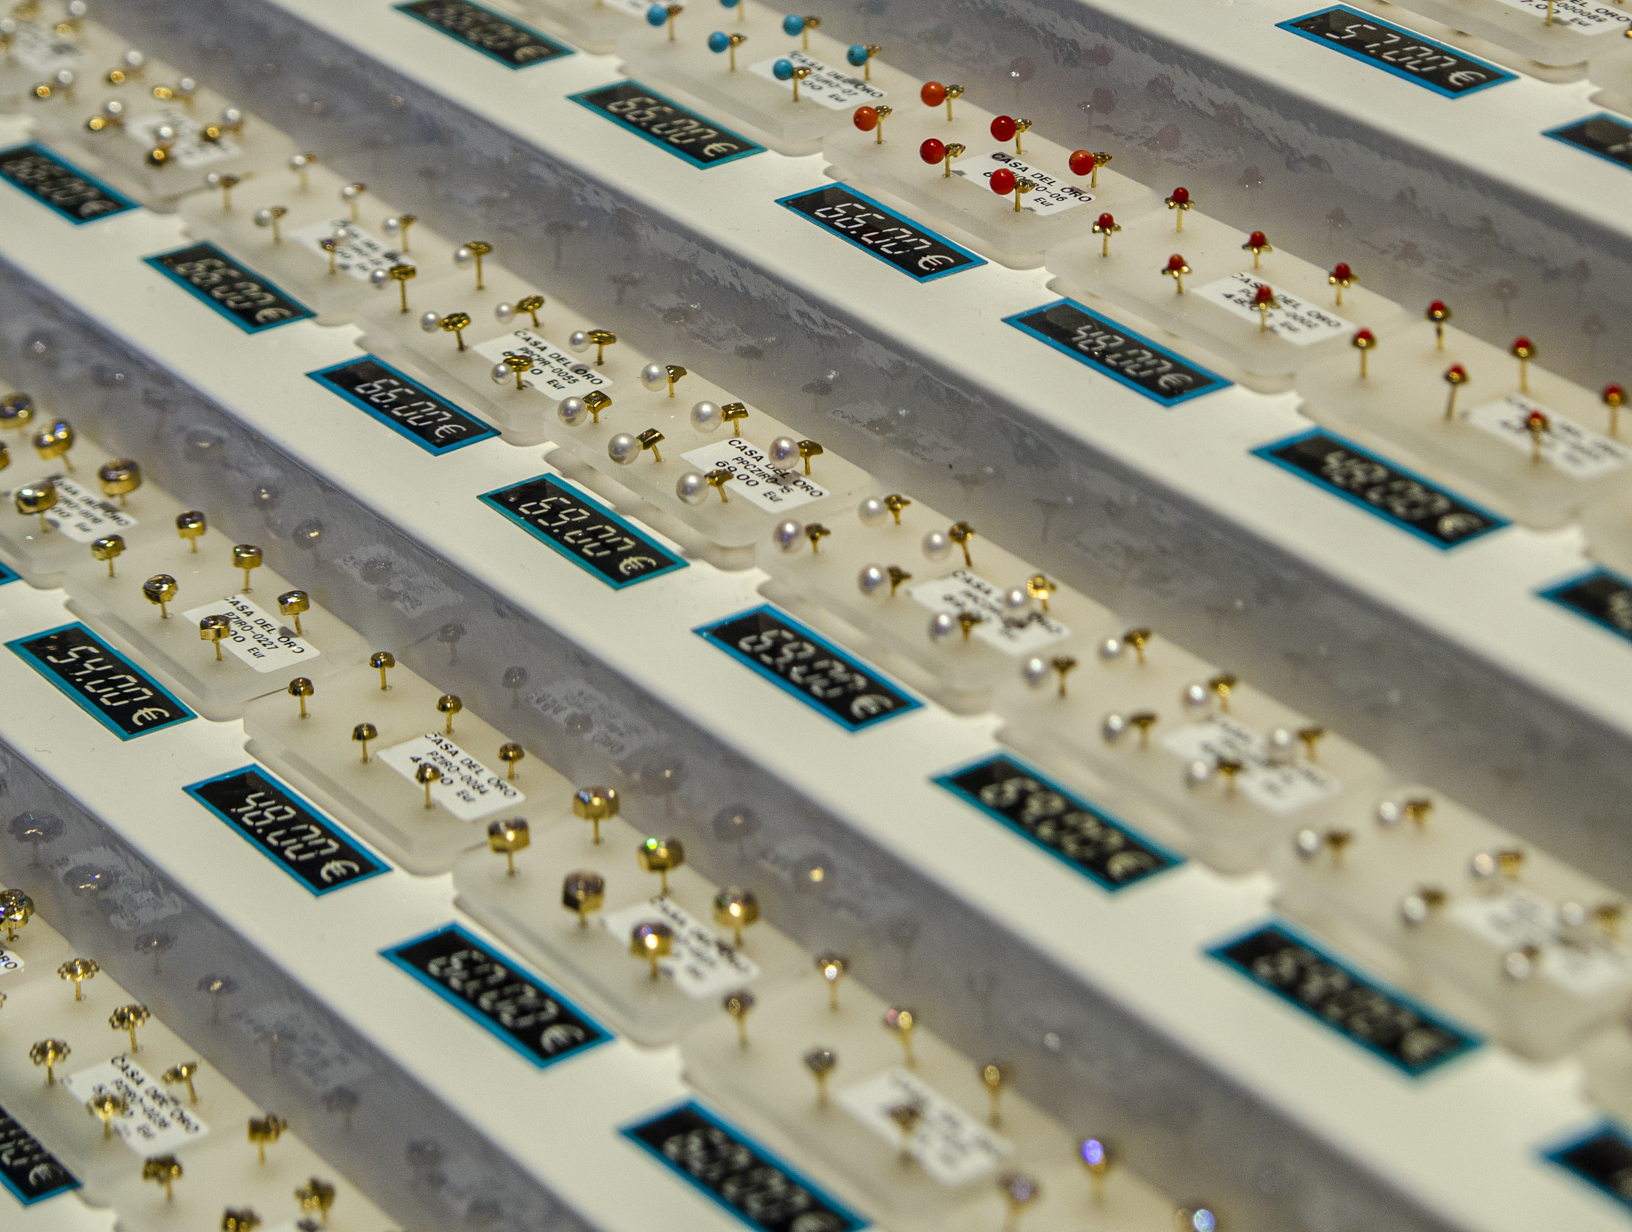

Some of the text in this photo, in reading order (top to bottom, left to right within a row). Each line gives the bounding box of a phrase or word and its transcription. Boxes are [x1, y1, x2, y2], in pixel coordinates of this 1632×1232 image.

[1570, 17, 1593, 28] Eur
[1595, 7, 1631, 23] ORO
[991, 153, 1092, 202] CASA DEL ORO
[1034, 197, 1054, 207] Eur
[514, 330, 548, 351] CASA
[548, 352, 574, 368] DEL
[574, 368, 604, 385] ORO
[518, 346, 579, 385] PPCPR-0055
[546, 378, 566, 390] Eur
[728, 439, 764, 462] CASA
[792, 479, 824, 498] ORO
[763, 490, 783, 503] Eur
[223, 611, 279, 651] PZIRO-0227
[254, 618, 276, 635] DEL
[278, 635, 305, 654] ORO
[246, 646, 266, 659] Eur
[425, 731, 459, 757] CASA
[460, 757, 484, 775] DEL
[487, 776, 517, 798] ORO
